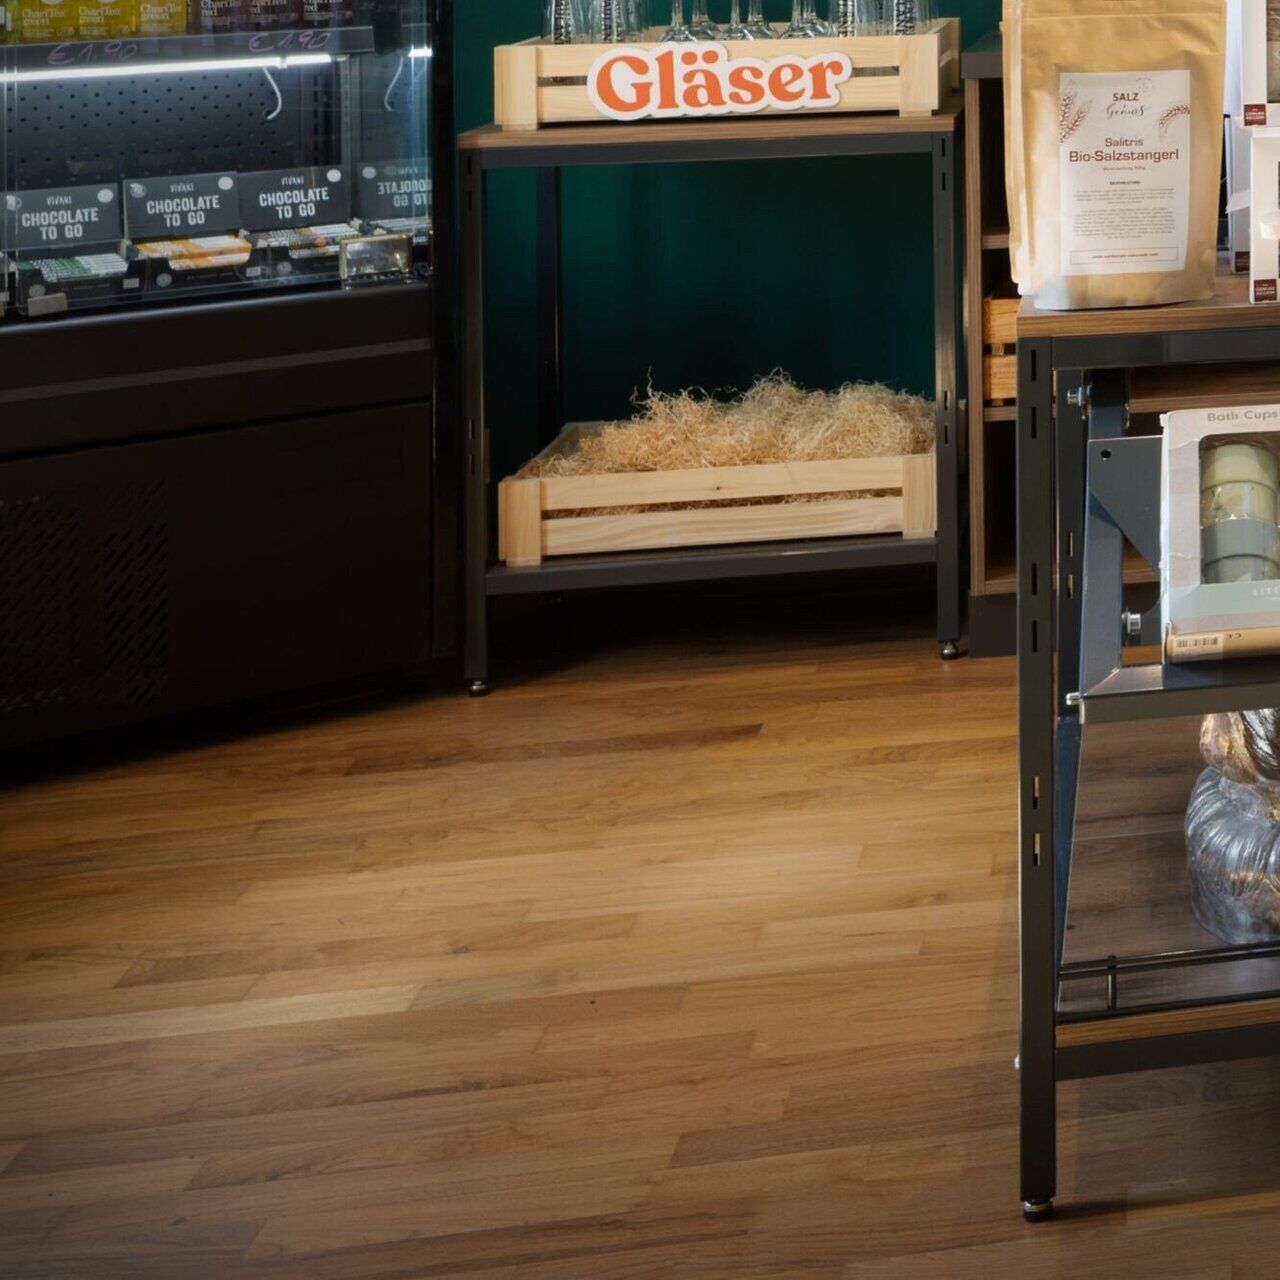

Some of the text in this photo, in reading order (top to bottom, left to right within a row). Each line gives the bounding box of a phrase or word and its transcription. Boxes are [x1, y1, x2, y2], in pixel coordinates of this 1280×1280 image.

[303, 2, 318, 12] red
[250, 31, 275, 52] €
[47, 43, 75, 65] €
[596, 49, 844, 113] Gläser
[1112, 93, 1139, 101] SALZ
[1105, 138, 1144, 147] Salitris
[1069, 149, 1179, 163] Bio-Salzstangerl
[146, 195, 220, 215] CHOCOLATE
[259, 187, 330, 208] CHOCOLATE
[21, 207, 100, 227] CHOCOLATE
[163, 211, 206, 227] TO GO
[275, 203, 316, 219] TO GO
[39, 224, 84, 241] TO GO
[1207, 410, 1239, 422] Bath
[1244, 409, 1278, 422] Cups
